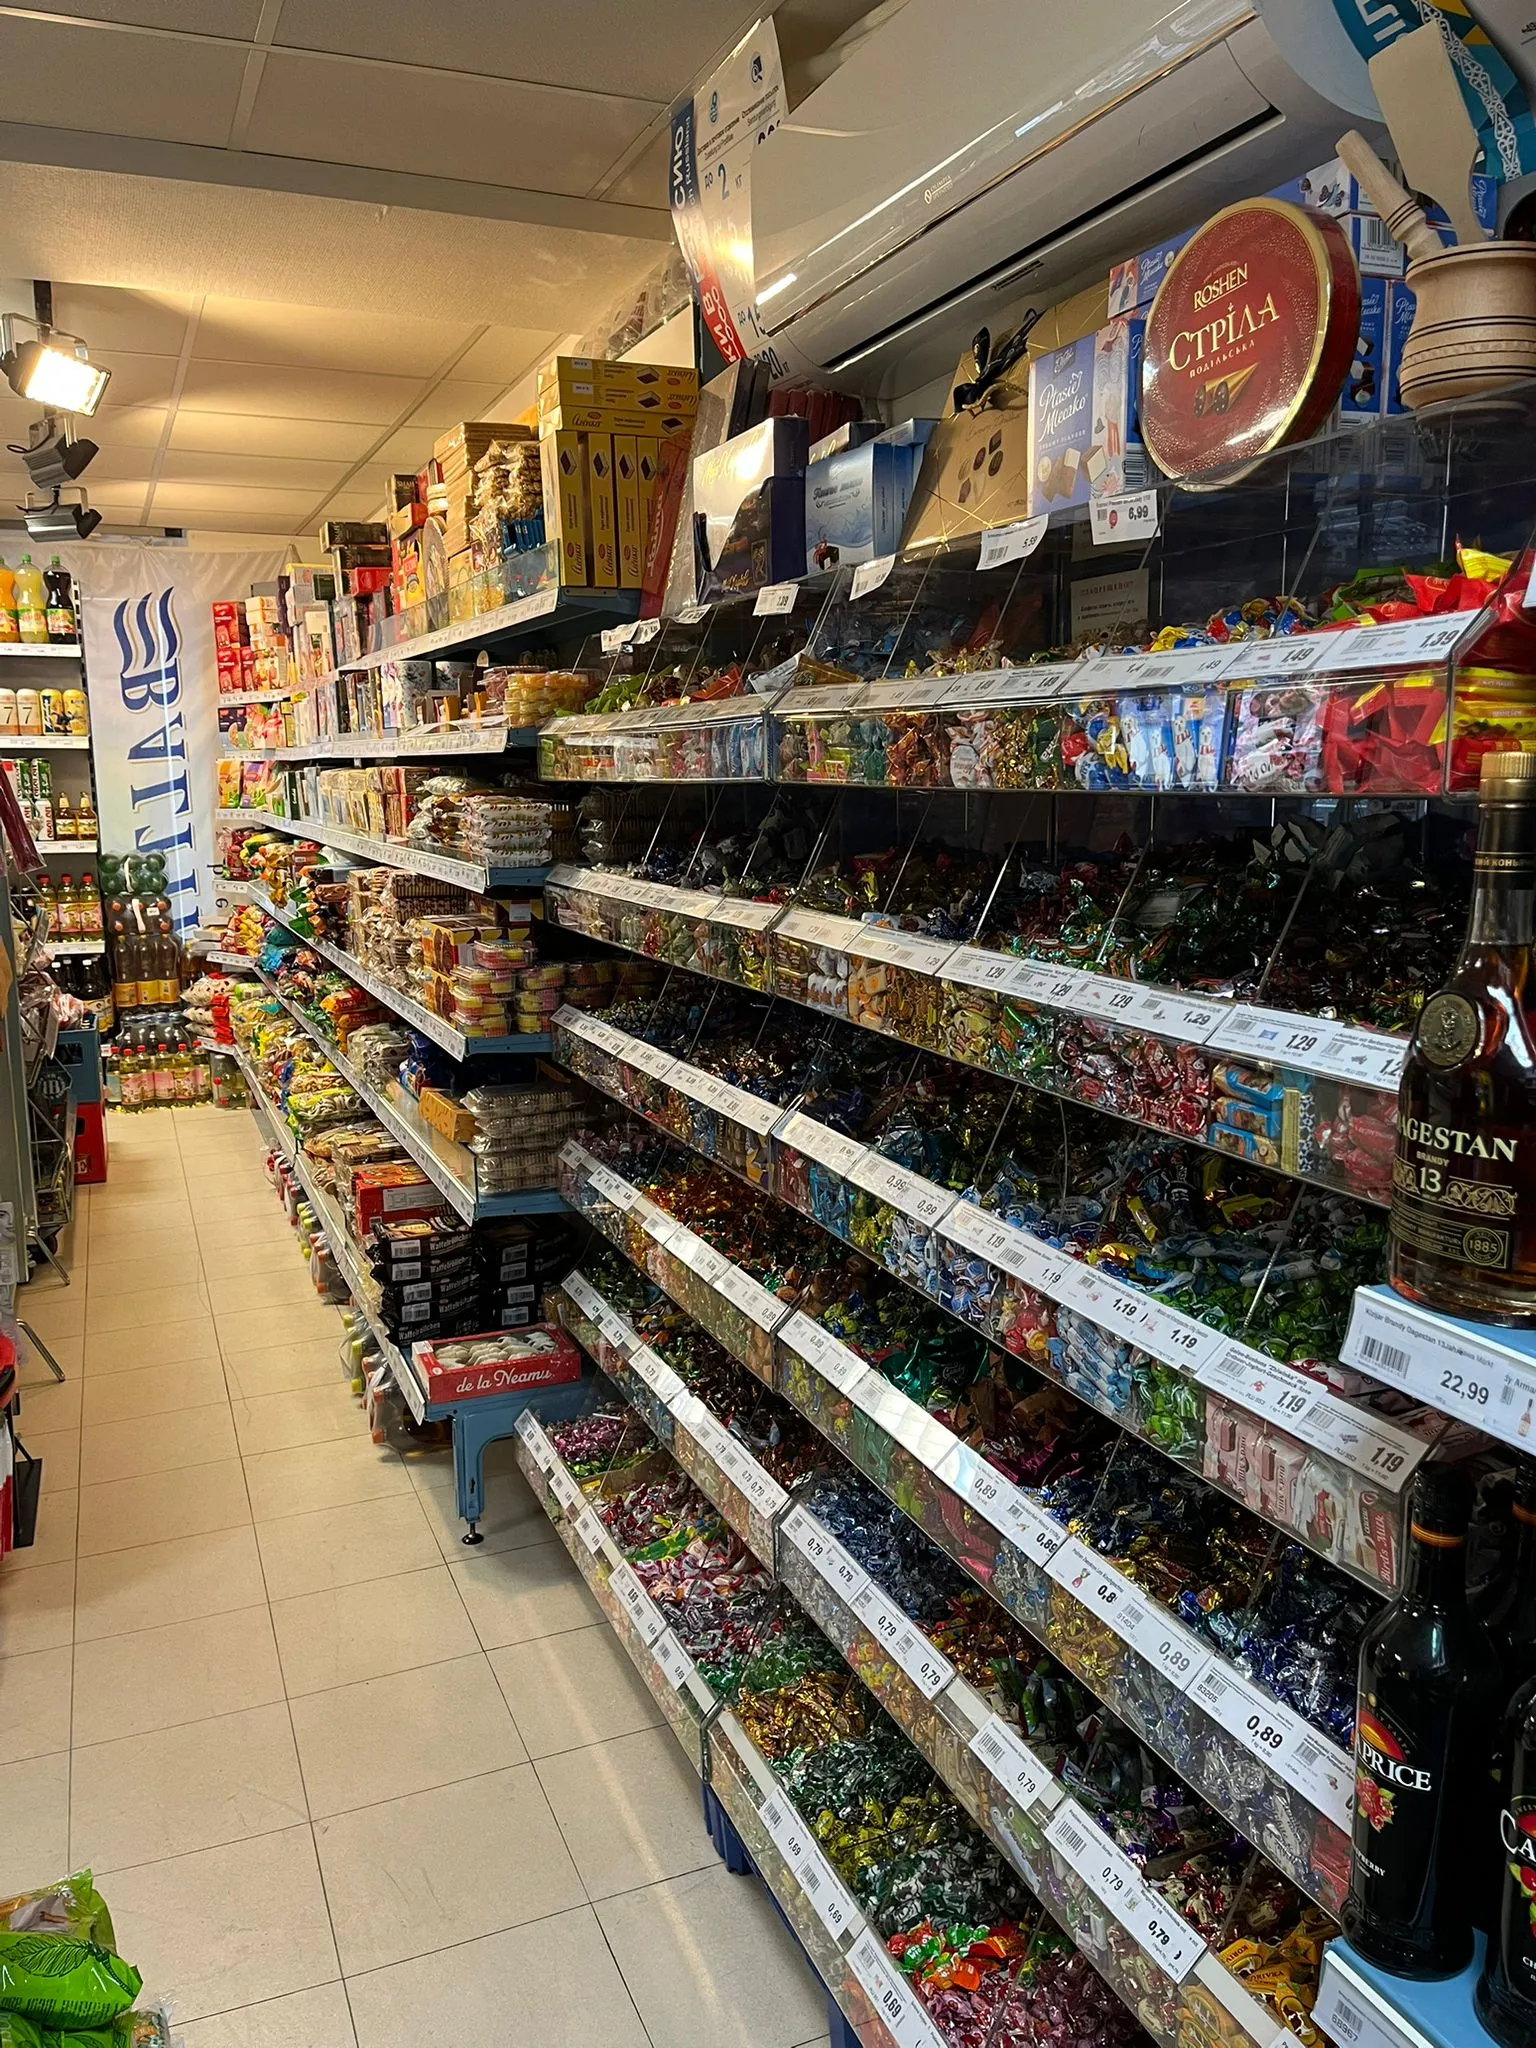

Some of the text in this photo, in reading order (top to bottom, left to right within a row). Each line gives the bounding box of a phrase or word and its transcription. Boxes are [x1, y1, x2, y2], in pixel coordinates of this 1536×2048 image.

[717, 163, 730, 201] 2
[1194, 263, 1248, 311] ROSHEN
[1168, 292, 1281, 372] СТРІЛА
[763, 346, 783, 381] 20
[1128, 504, 1150, 521] 6,99
[1420, 629, 1460, 650] 1,39
[1281, 647, 1313, 664] 1,49
[22, 706, 33, 725] 7
[985, 967, 1006, 980] 1,29
[1049, 983, 1073, 997] 1,29
[1107, 993, 1133, 1009] 1,29
[1182, 1011, 1211, 1026] 1,29
[1284, 1032, 1319, 1052] 1,29
[1397, 1113, 1518, 1163] AGESTAN
[1416, 1150, 1450, 1167] BRANDY
[886, 1174, 907, 1191] 0,99
[1420, 1167, 1442, 1193] 13
[917, 1199, 938, 1215] 0,99
[987, 1233, 1006, 1249] 1,19
[1469, 1238, 1498, 1254] 1885
[1041, 1268, 1062, 1284] 1,19
[1112, 1298, 1138, 1316] 1,19
[1170, 1328, 1198, 1349] 1,19
[456, 1375, 475, 1393] de
[476, 1373, 492, 1390] la
[1439, 1369, 1490, 1406] 22,99
[1276, 1391, 1307, 1414] 1,19
[1369, 1446, 1406, 1474] 1,19
[750, 1480, 765, 1498] 0,79
[974, 1478, 997, 1500] 0,89
[807, 1537, 824, 1557] 0,79
[1036, 1532, 1059, 1554] 0,89
[838, 1565, 854, 1583] 0,79
[877, 1615, 897, 1637] 0,79
[1158, 1640, 1191, 1673] 0,89
[920, 1662, 941, 1686] 0,79
[1246, 1714, 1284, 1750] 0,89
[1017, 1771, 1037, 1794] 0,79
[786, 1836, 802, 1857] 0,69
[1101, 1866, 1124, 1891] 0,79
[826, 1902, 843, 1925] 0,69
[1148, 1920, 1170, 1946] 0,79
[882, 1989, 903, 2019] 0,69
[1330, 2012, 1360, 2043] 68967
